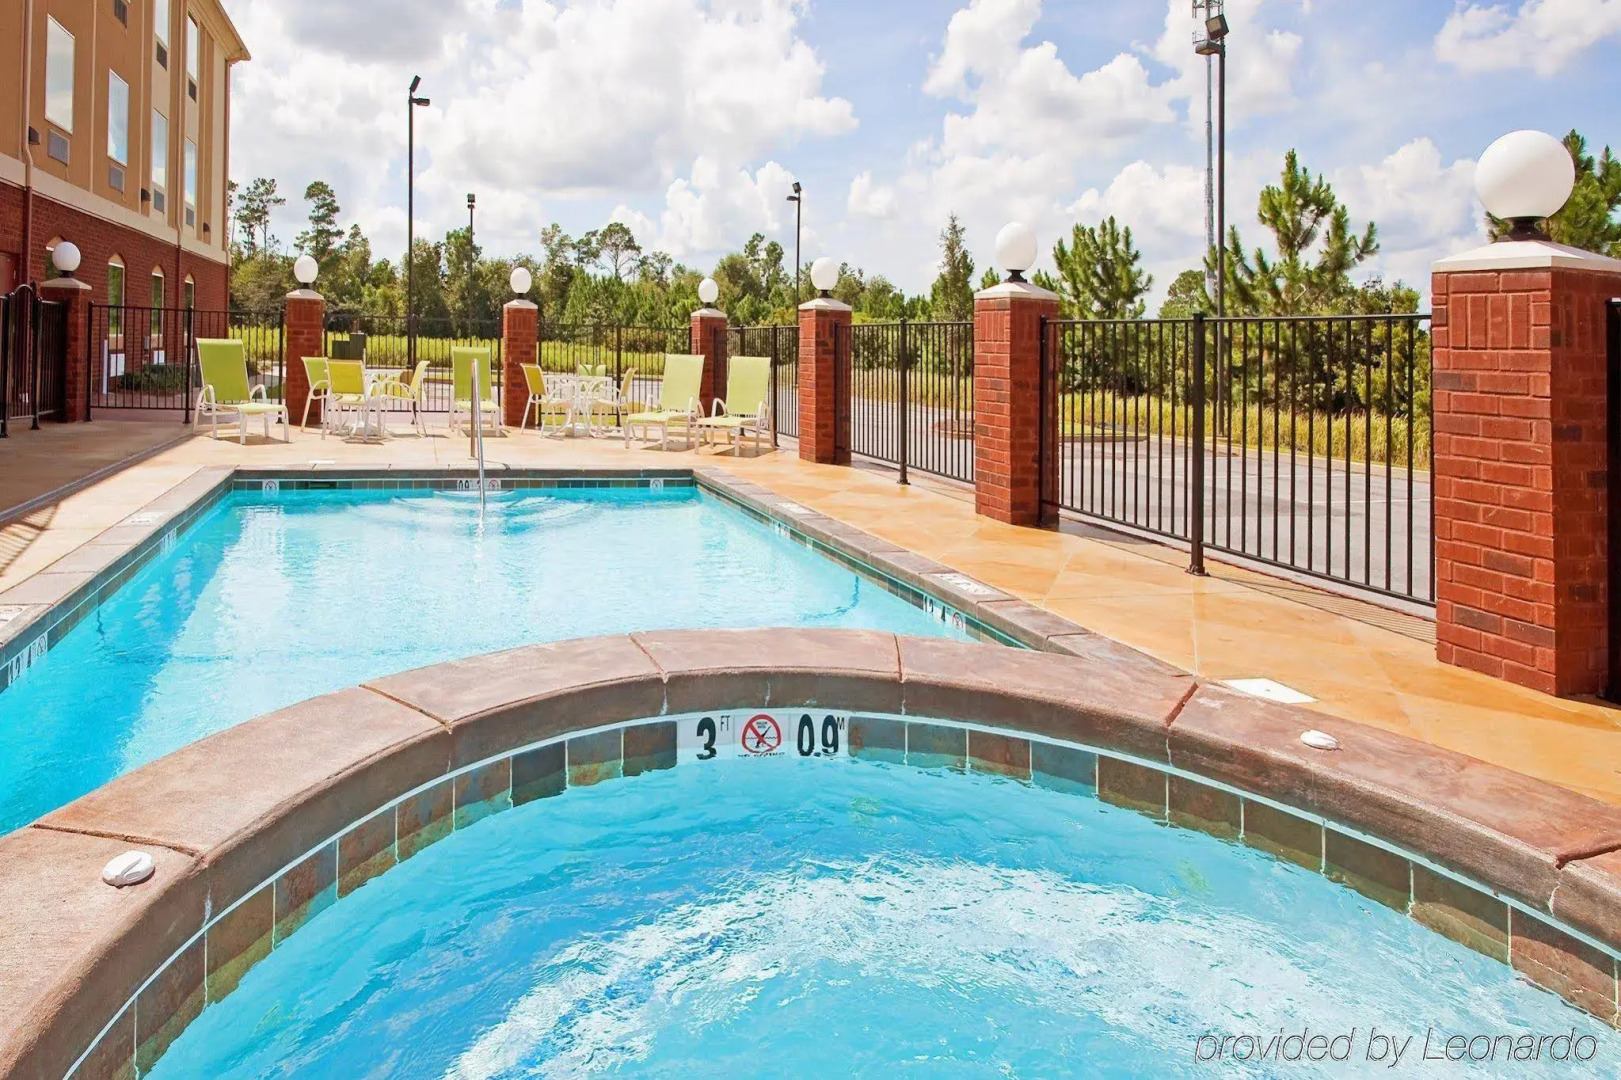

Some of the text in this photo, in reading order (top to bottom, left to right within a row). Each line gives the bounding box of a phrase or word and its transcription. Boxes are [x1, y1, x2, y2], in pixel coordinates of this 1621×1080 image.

[696, 715, 730, 760] 3 FT
[797, 714, 838, 757] 0.9
